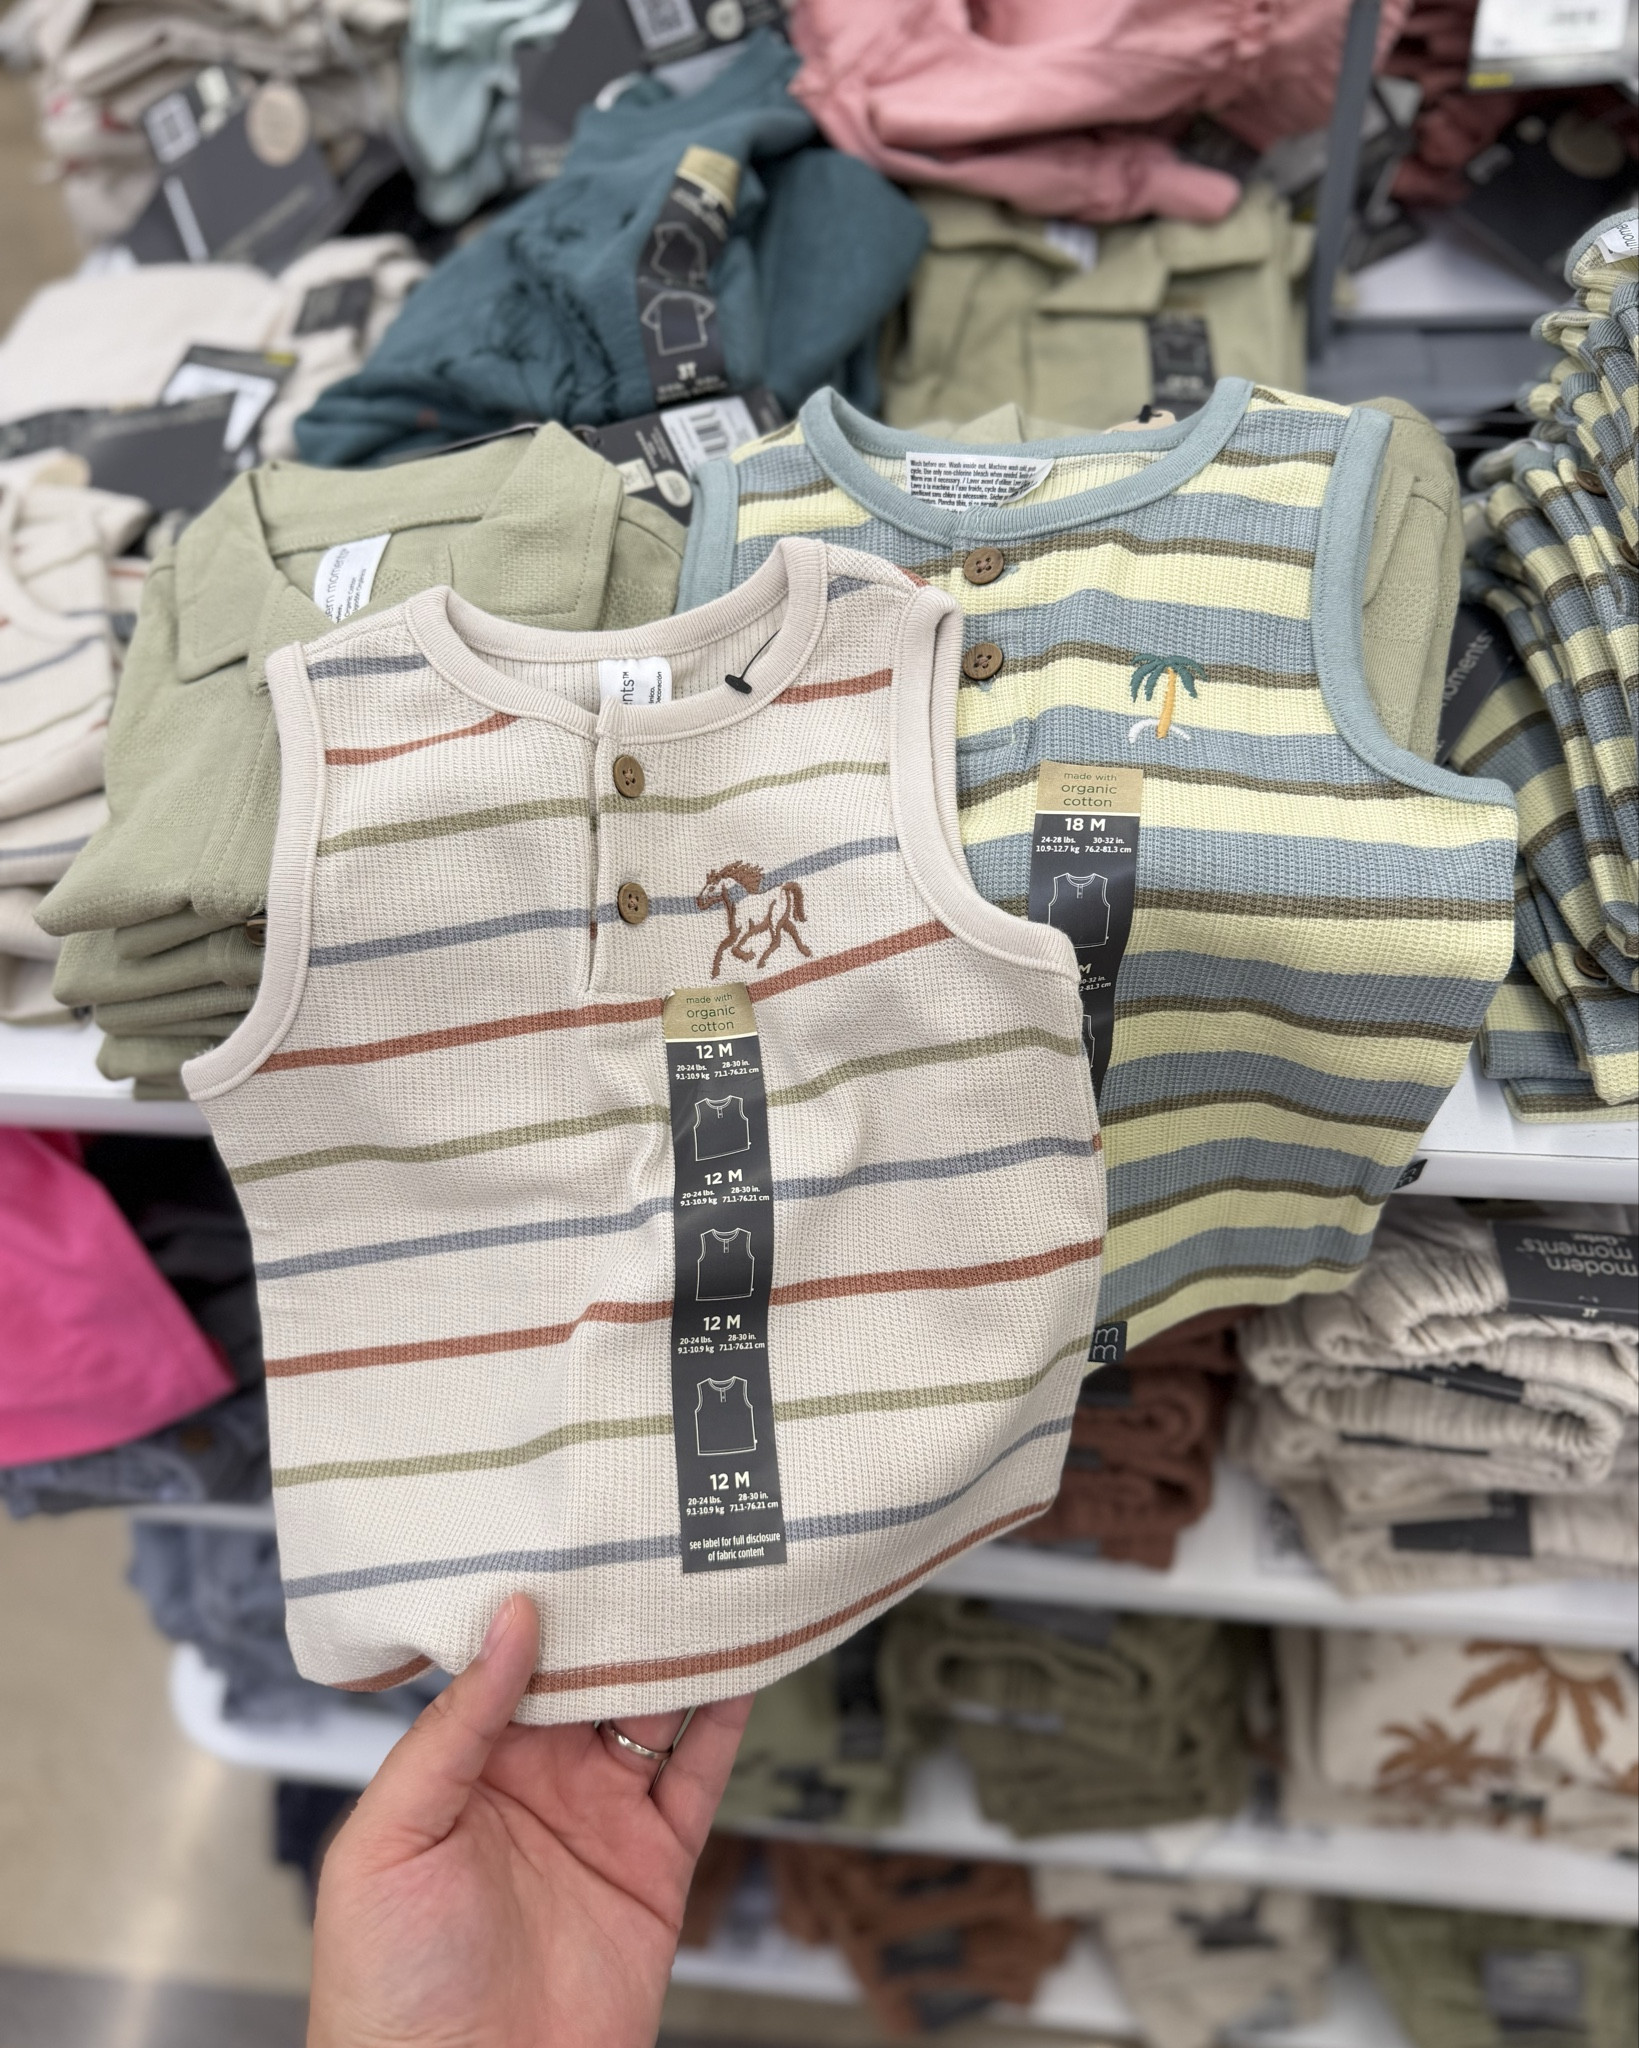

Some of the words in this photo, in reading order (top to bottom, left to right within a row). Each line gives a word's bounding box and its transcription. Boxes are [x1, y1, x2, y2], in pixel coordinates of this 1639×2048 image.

[1063, 772, 1092, 780] made
[1095, 773, 1117, 781] with
[1061, 784, 1118, 795] organic
[1063, 797, 1113, 807] cotton
[1065, 817, 1084, 831] 18
[1090, 818, 1106, 832] M
[1063, 836, 1076, 844] lbs.
[1070, 845, 1080, 854] kg
[686, 995, 711, 1004] made
[714, 993, 733, 1002] with
[686, 1005, 736, 1020] organic
[691, 1021, 735, 1032] cotton
[696, 1045, 714, 1059] 12
[718, 1043, 733, 1058] M
[676, 1064, 695, 1072] 20-24
[695, 1063, 707, 1071] lbs.
[722, 1060, 741, 1068] 28-30
[701, 1072, 710, 1081] kg
[714, 1068, 748, 1078] 71.1-76.21
[704, 1171, 723, 1186] 12
[728, 1168, 743, 1183] M
[682, 1190, 702, 1199] 20-24
[730, 1186, 751, 1194] 28-30
[751, 1185, 761, 1193] in.
[680, 1197, 708, 1206] 9.1-10.9
[708, 1197, 718, 1205] kg
[722, 1194, 758, 1203] 71.1-76.21
[1546, 1257, 1638, 1277] modern
[703, 1316, 721, 1331] 12
[726, 1314, 741, 1330] M
[680, 1337, 700, 1345] 20-24
[727, 1333, 747, 1341] 28-30
[677, 1345, 705, 1354] 9.1-10.9
[705, 1345, 714, 1353] kg
[719, 1342, 753, 1351] 71.1-76.21
[754, 1341, 765, 1349] cm
[709, 1473, 729, 1491] 12
[734, 1470, 750, 1489] M
[687, 1497, 708, 1506] 20-24
[738, 1492, 759, 1501] 28-30
[759, 1491, 769, 1499] in.
[686, 1506, 714, 1516] 9.1-10.9
[714, 1505, 725, 1515] kg
[729, 1502, 766, 1512] 71.1-76.21
[689, 1541, 701, 1550] see
[702, 1538, 720, 1548] label
[721, 1536, 732, 1547] for
[732, 1535, 745, 1546] full
[746, 1532, 781, 1544] disclosure
[708, 1551, 715, 1561] of
[716, 1550, 737, 1561] fabric
[738, 1546, 765, 1558] content
